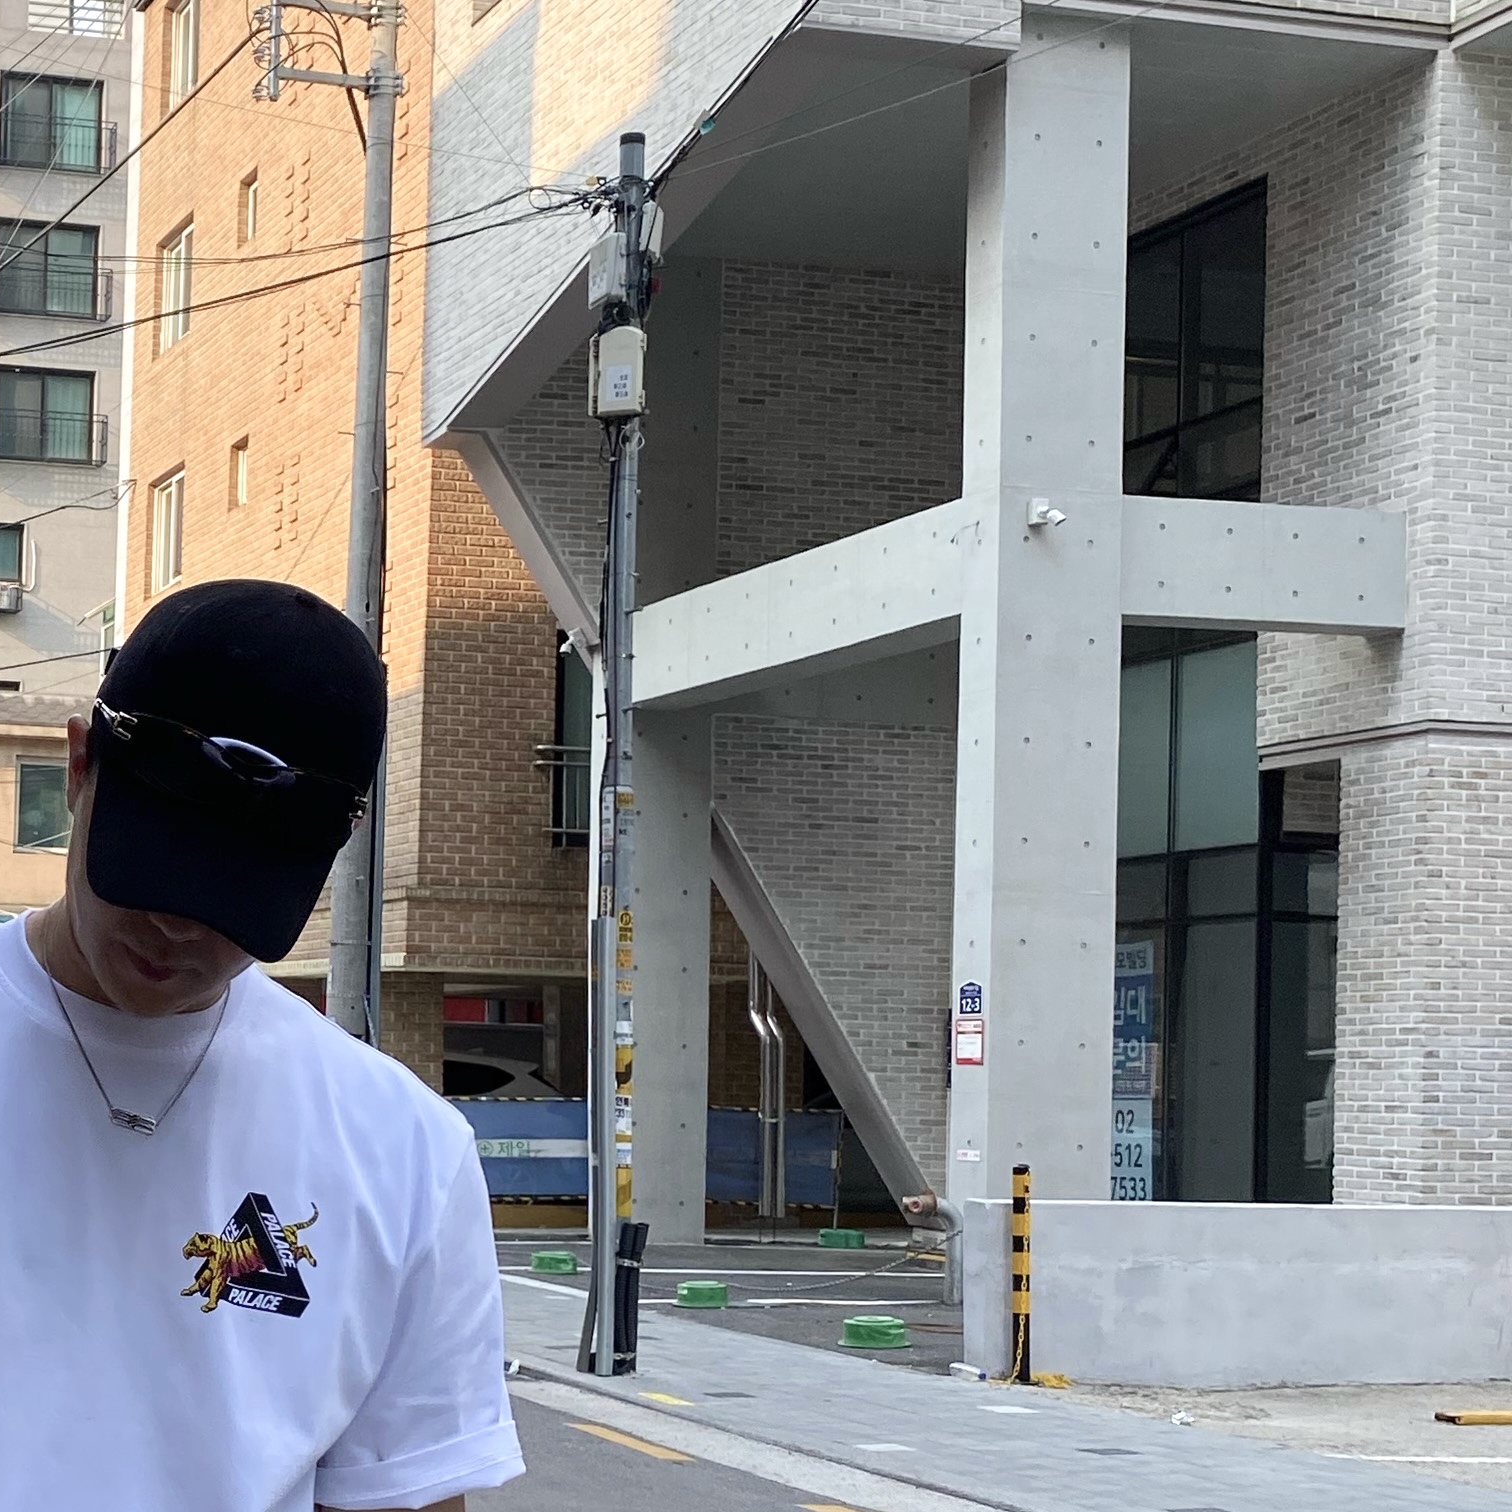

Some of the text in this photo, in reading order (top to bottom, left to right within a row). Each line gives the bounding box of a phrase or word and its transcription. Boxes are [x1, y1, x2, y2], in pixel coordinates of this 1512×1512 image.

[1115, 1109, 1135, 1134] 02
[261, 1211, 297, 1269] PALACE
[228, 1288, 283, 1312] PALACE
